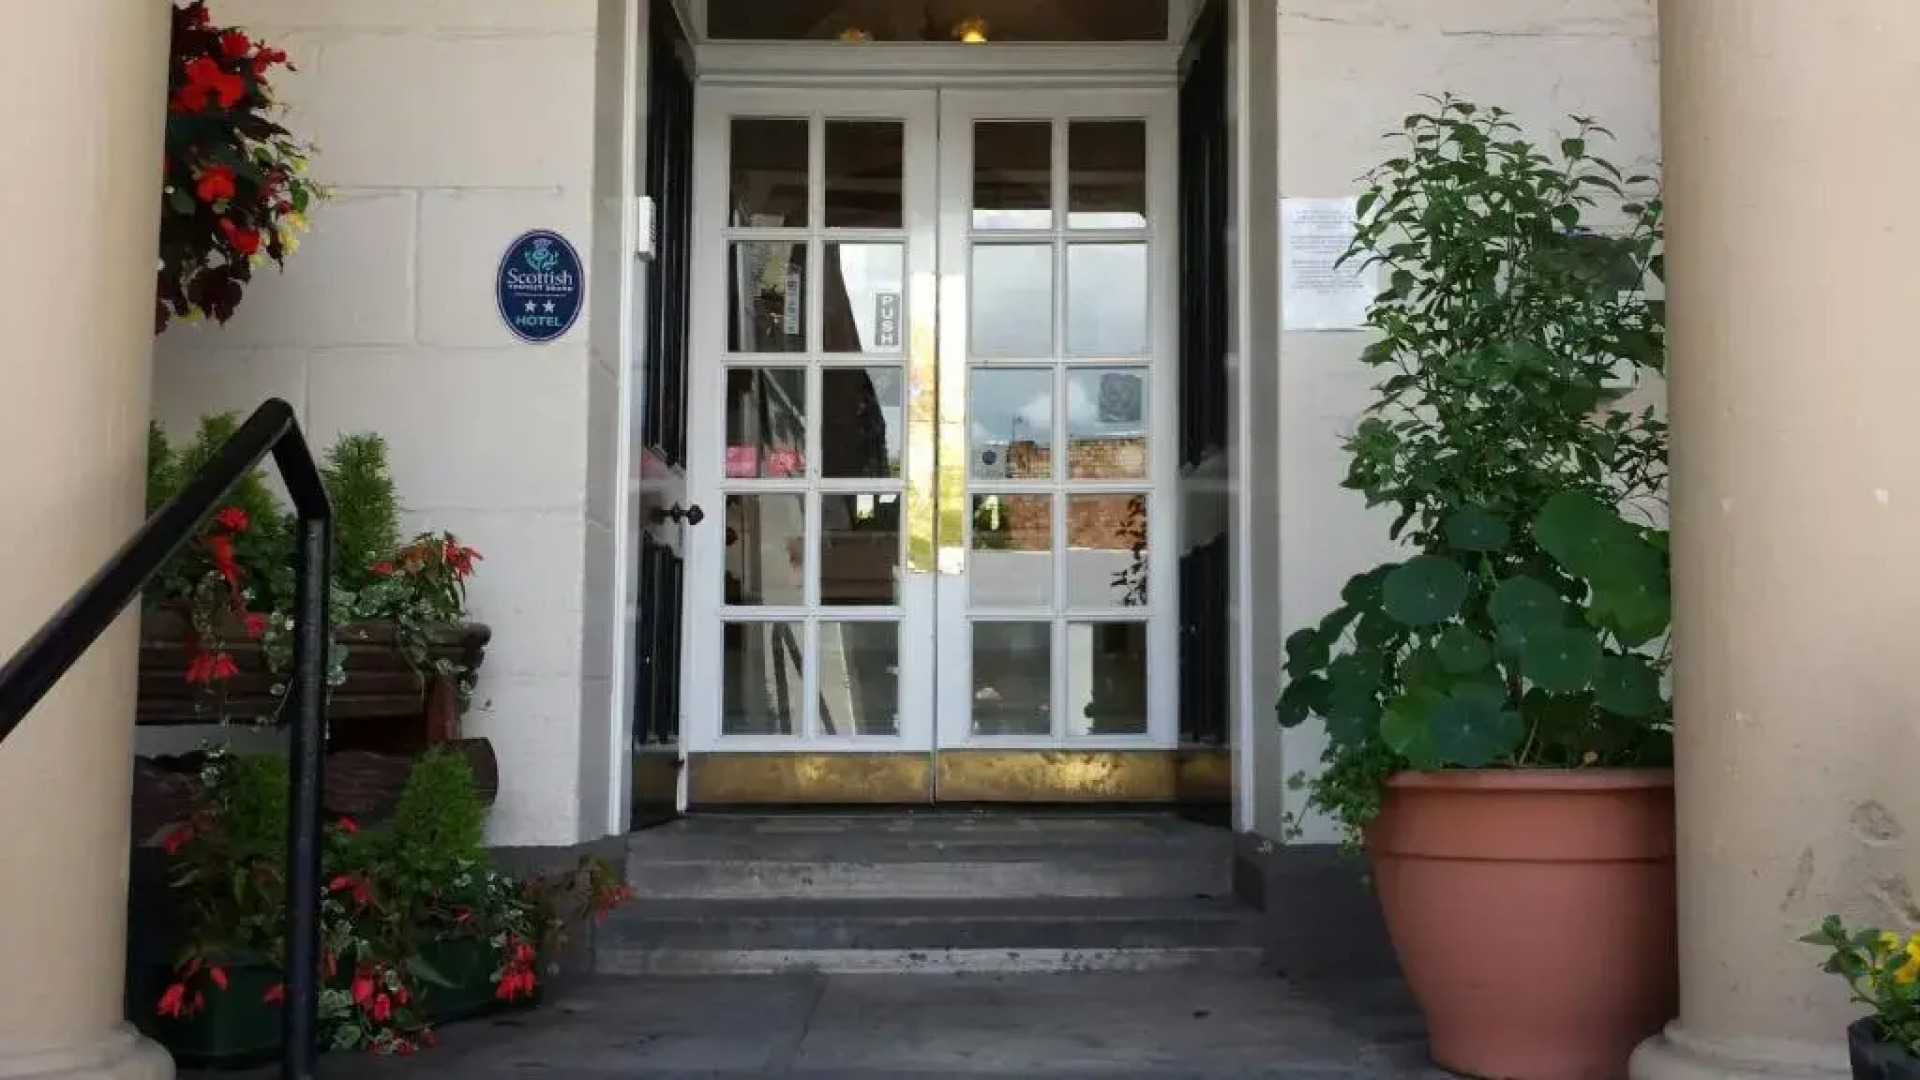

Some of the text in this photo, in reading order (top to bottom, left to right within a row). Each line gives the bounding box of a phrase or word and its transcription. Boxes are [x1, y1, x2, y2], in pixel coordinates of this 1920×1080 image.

[507, 267, 573, 285] Scottish
[516, 316, 562, 326] HOTEL
[881, 295, 894, 344] PUSH
